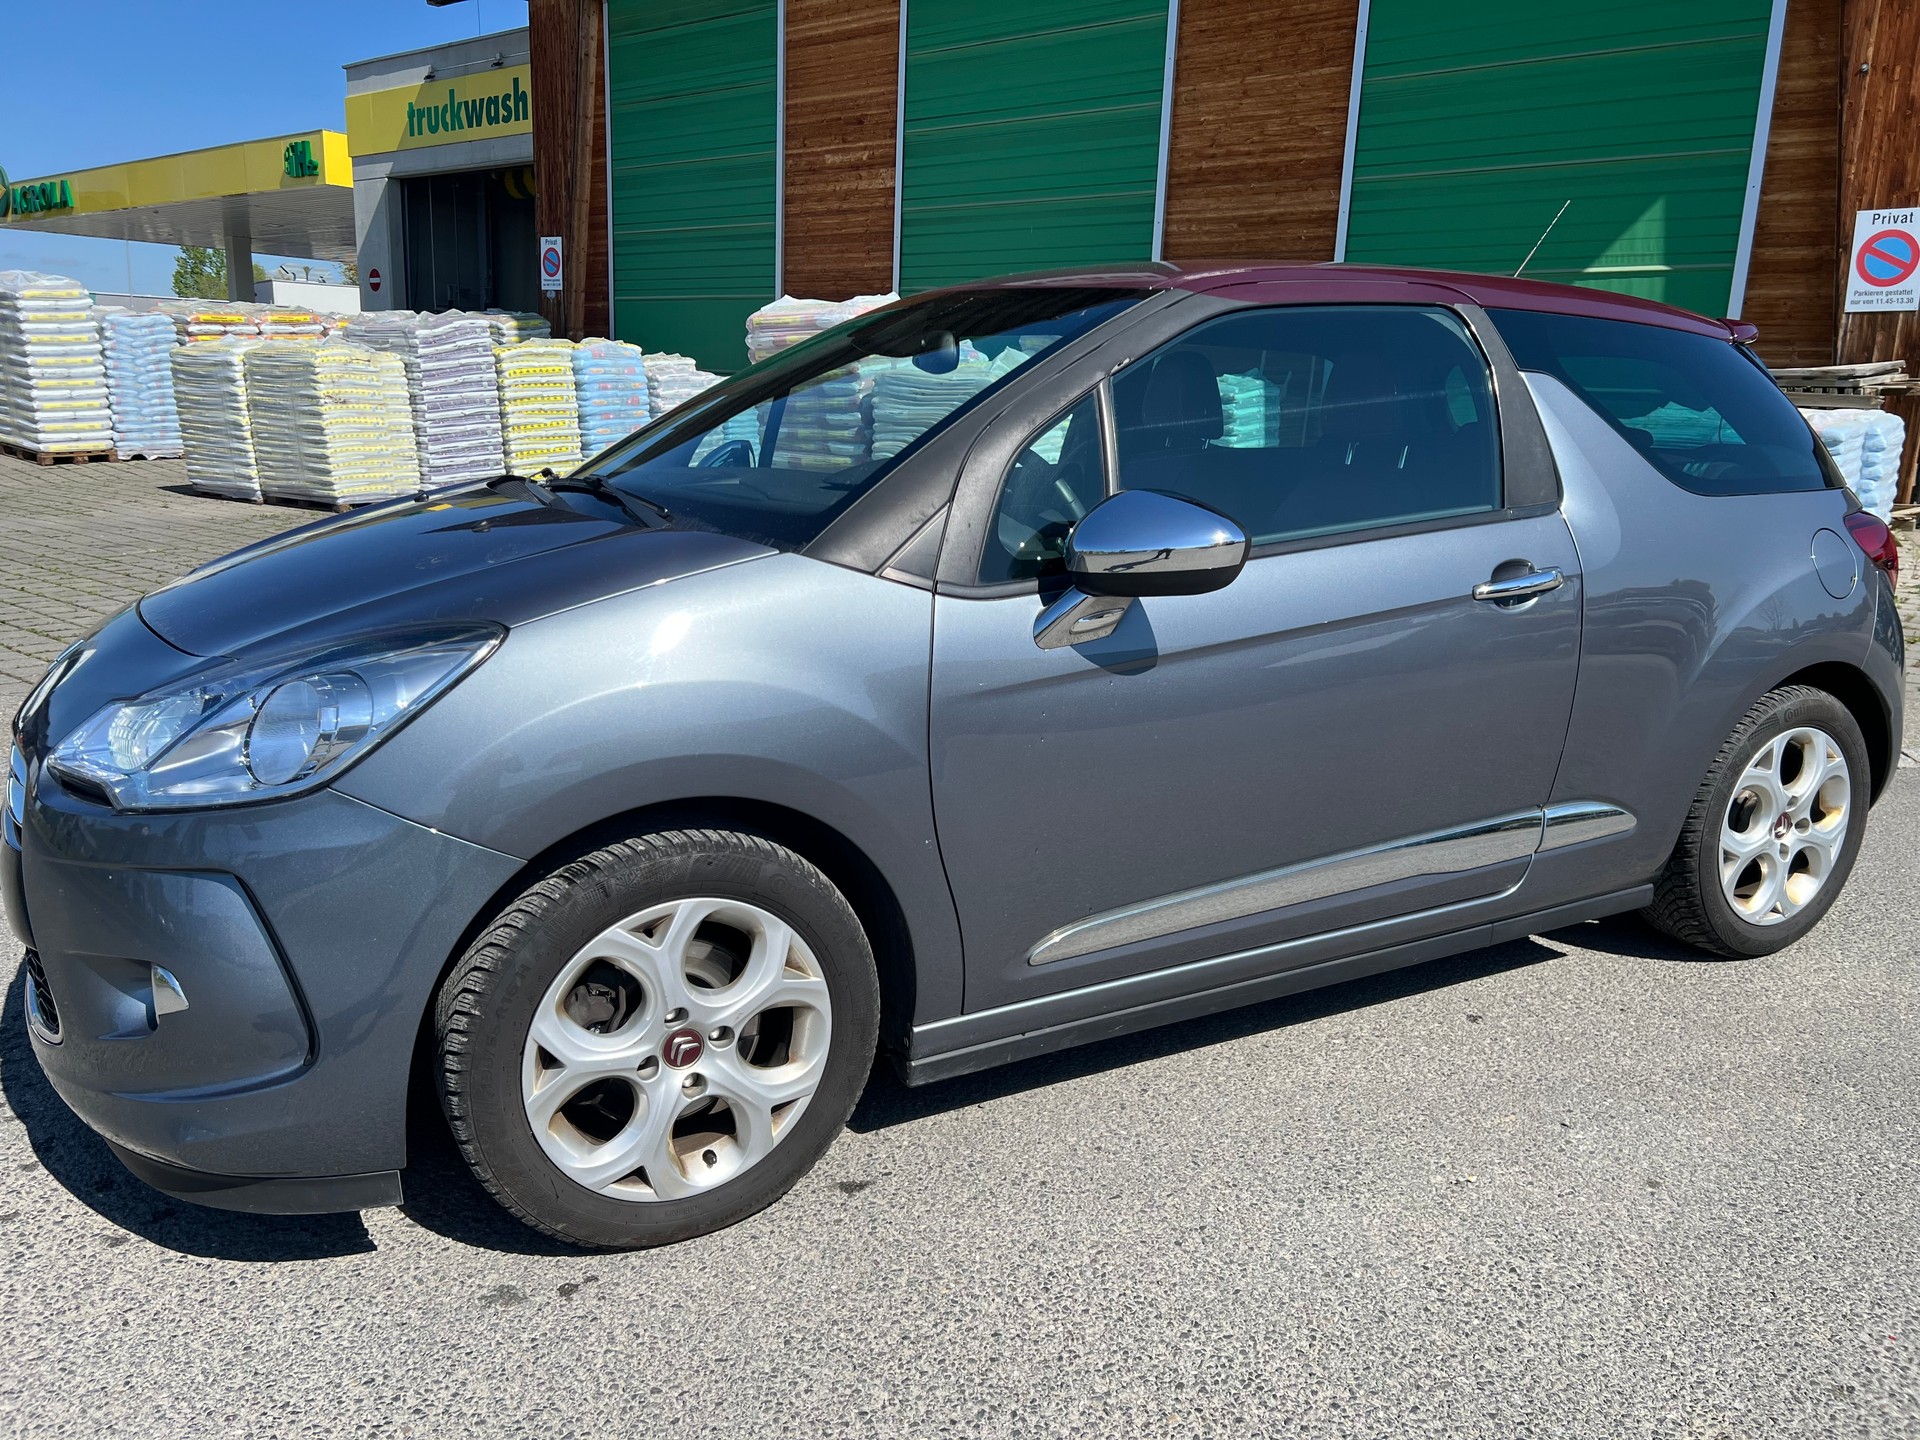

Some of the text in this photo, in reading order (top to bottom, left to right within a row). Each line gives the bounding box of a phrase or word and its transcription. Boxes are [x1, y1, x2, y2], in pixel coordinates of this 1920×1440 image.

[407, 77, 528, 137] truckwash
[12, 179, 75, 215] AGROLA
[1871, 212, 1914, 225] Privat
[1884, 289, 1913, 298] gestattet
[1876, 297, 1914, 305] 11.45-13.30
